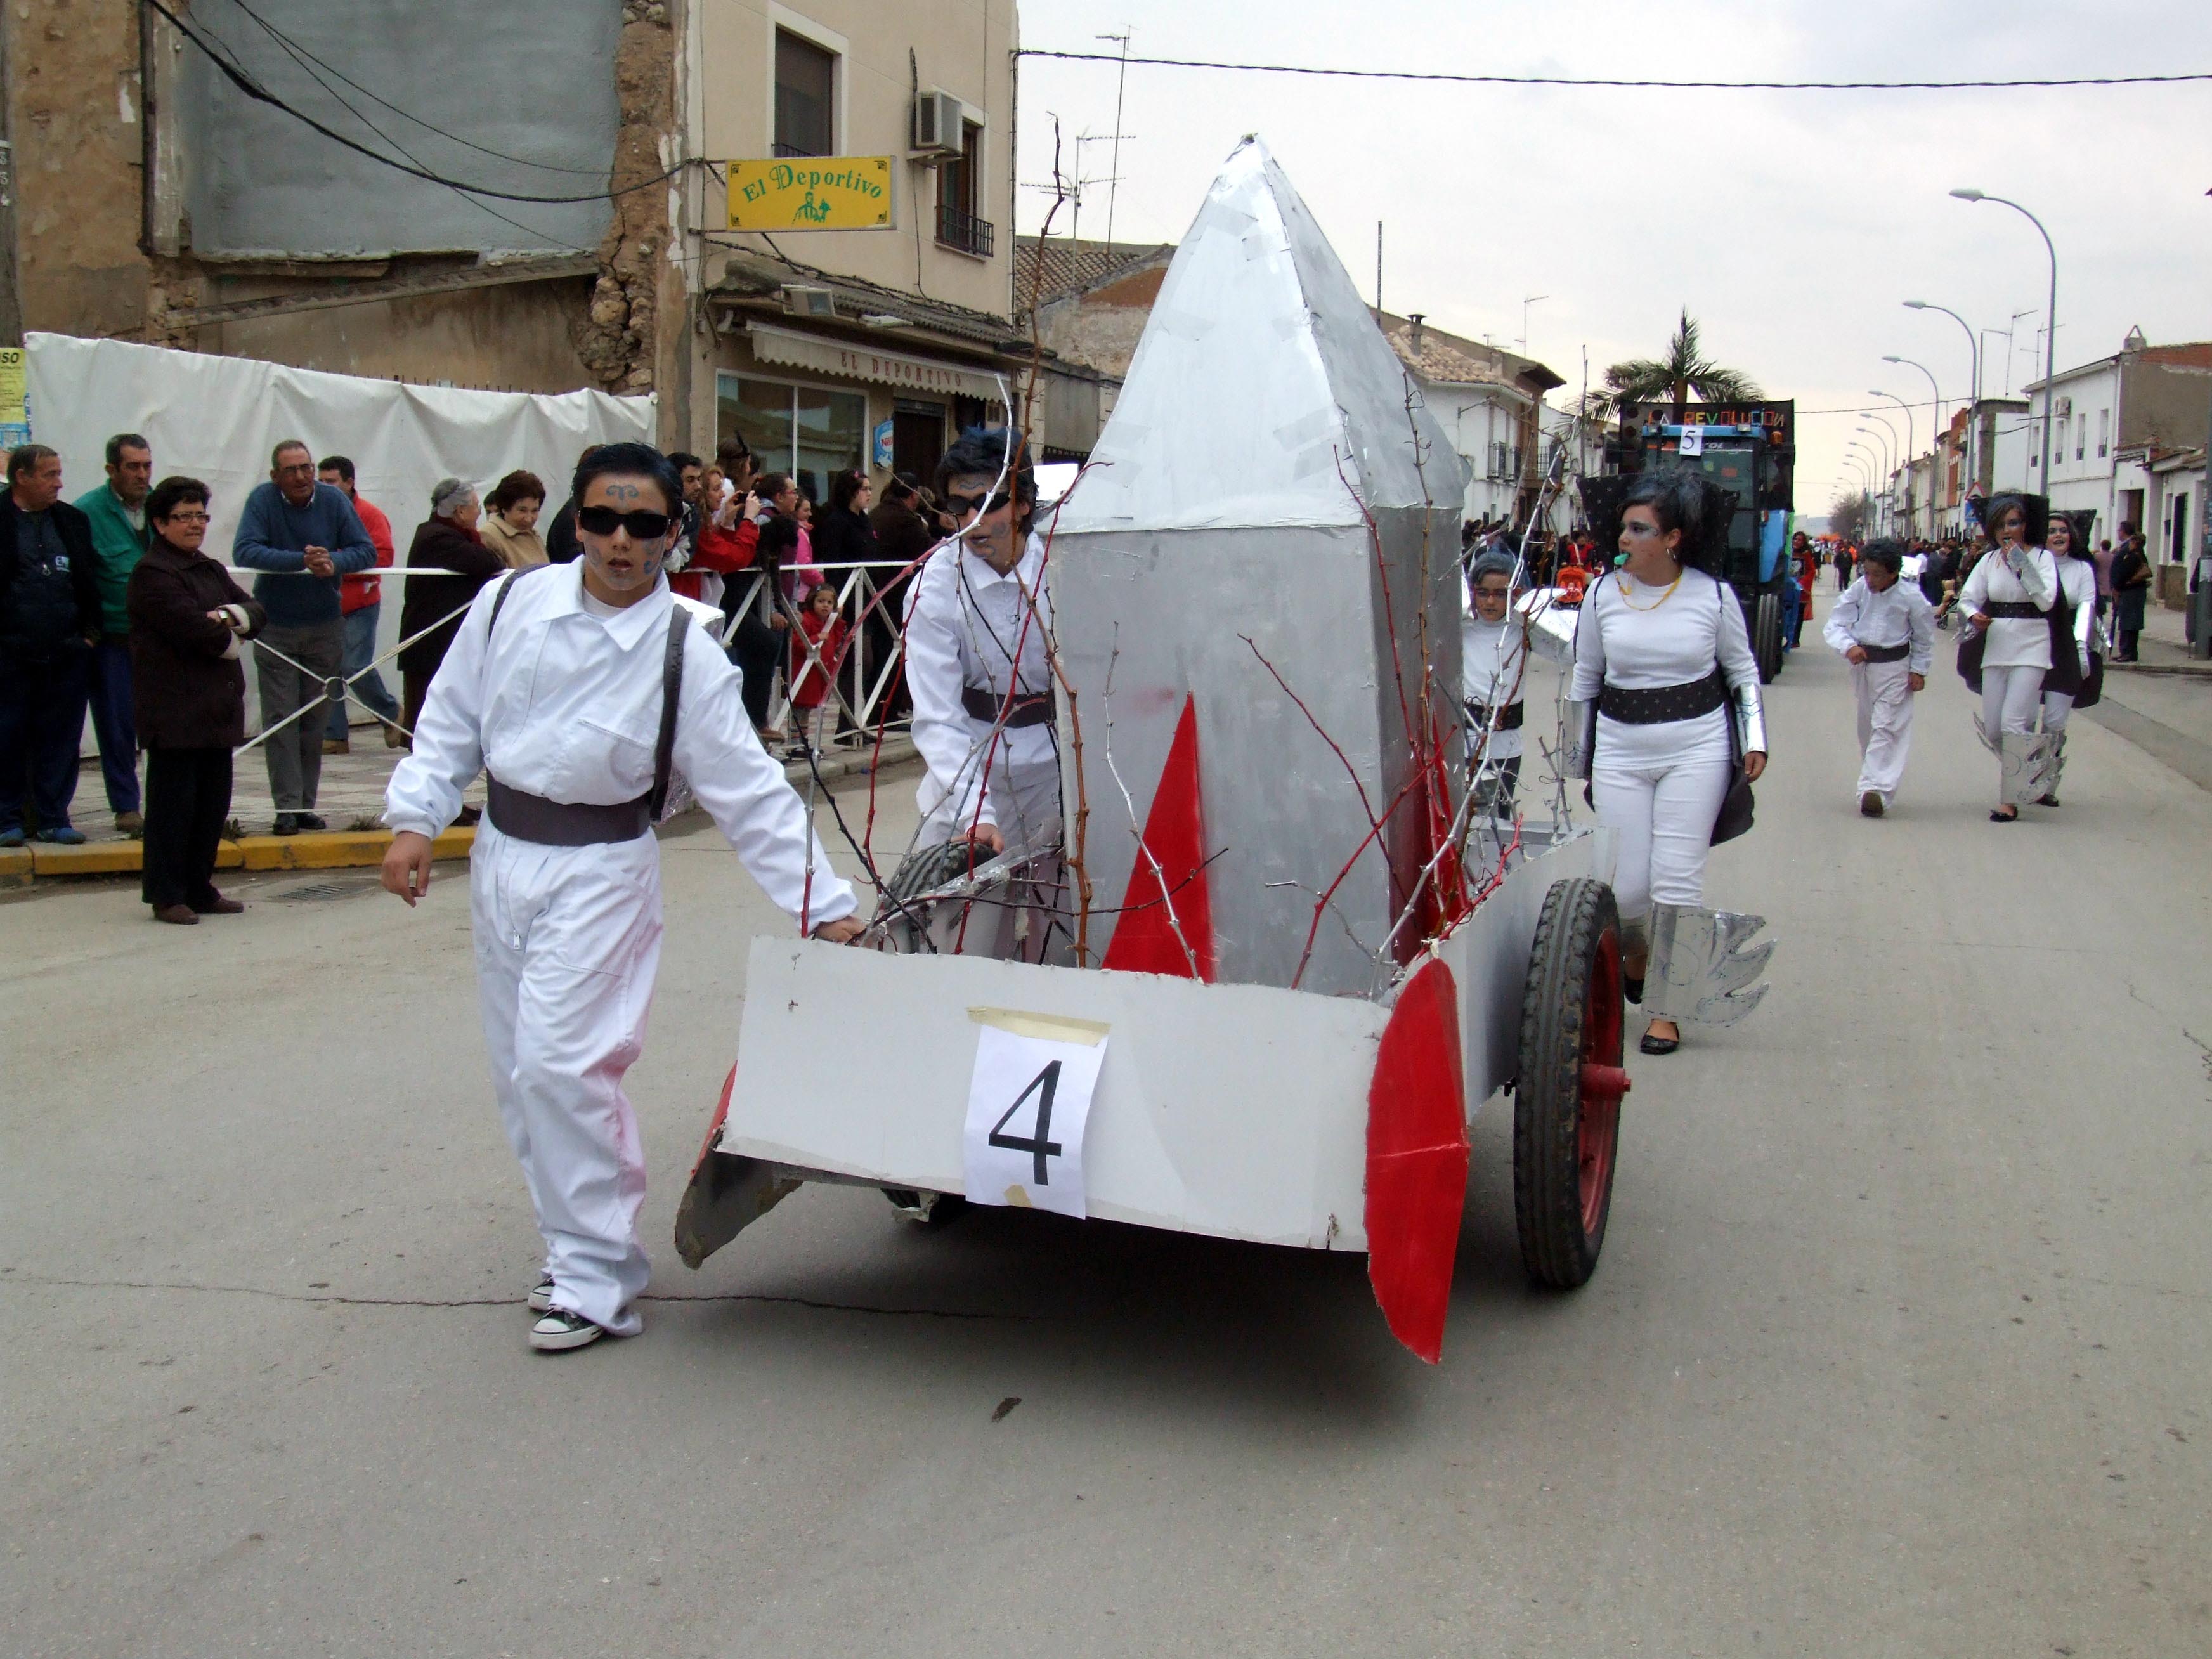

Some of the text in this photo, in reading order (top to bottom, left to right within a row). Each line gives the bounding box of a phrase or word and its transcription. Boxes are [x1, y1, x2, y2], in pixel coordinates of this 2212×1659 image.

[741, 164, 882, 203] El Deportivo
[0, 352, 19, 364] SO
[841, 351, 961, 387] EL DEPORTIVO
[1682, 430, 1696, 450] 5
[988, 1060, 1062, 1186] 4
